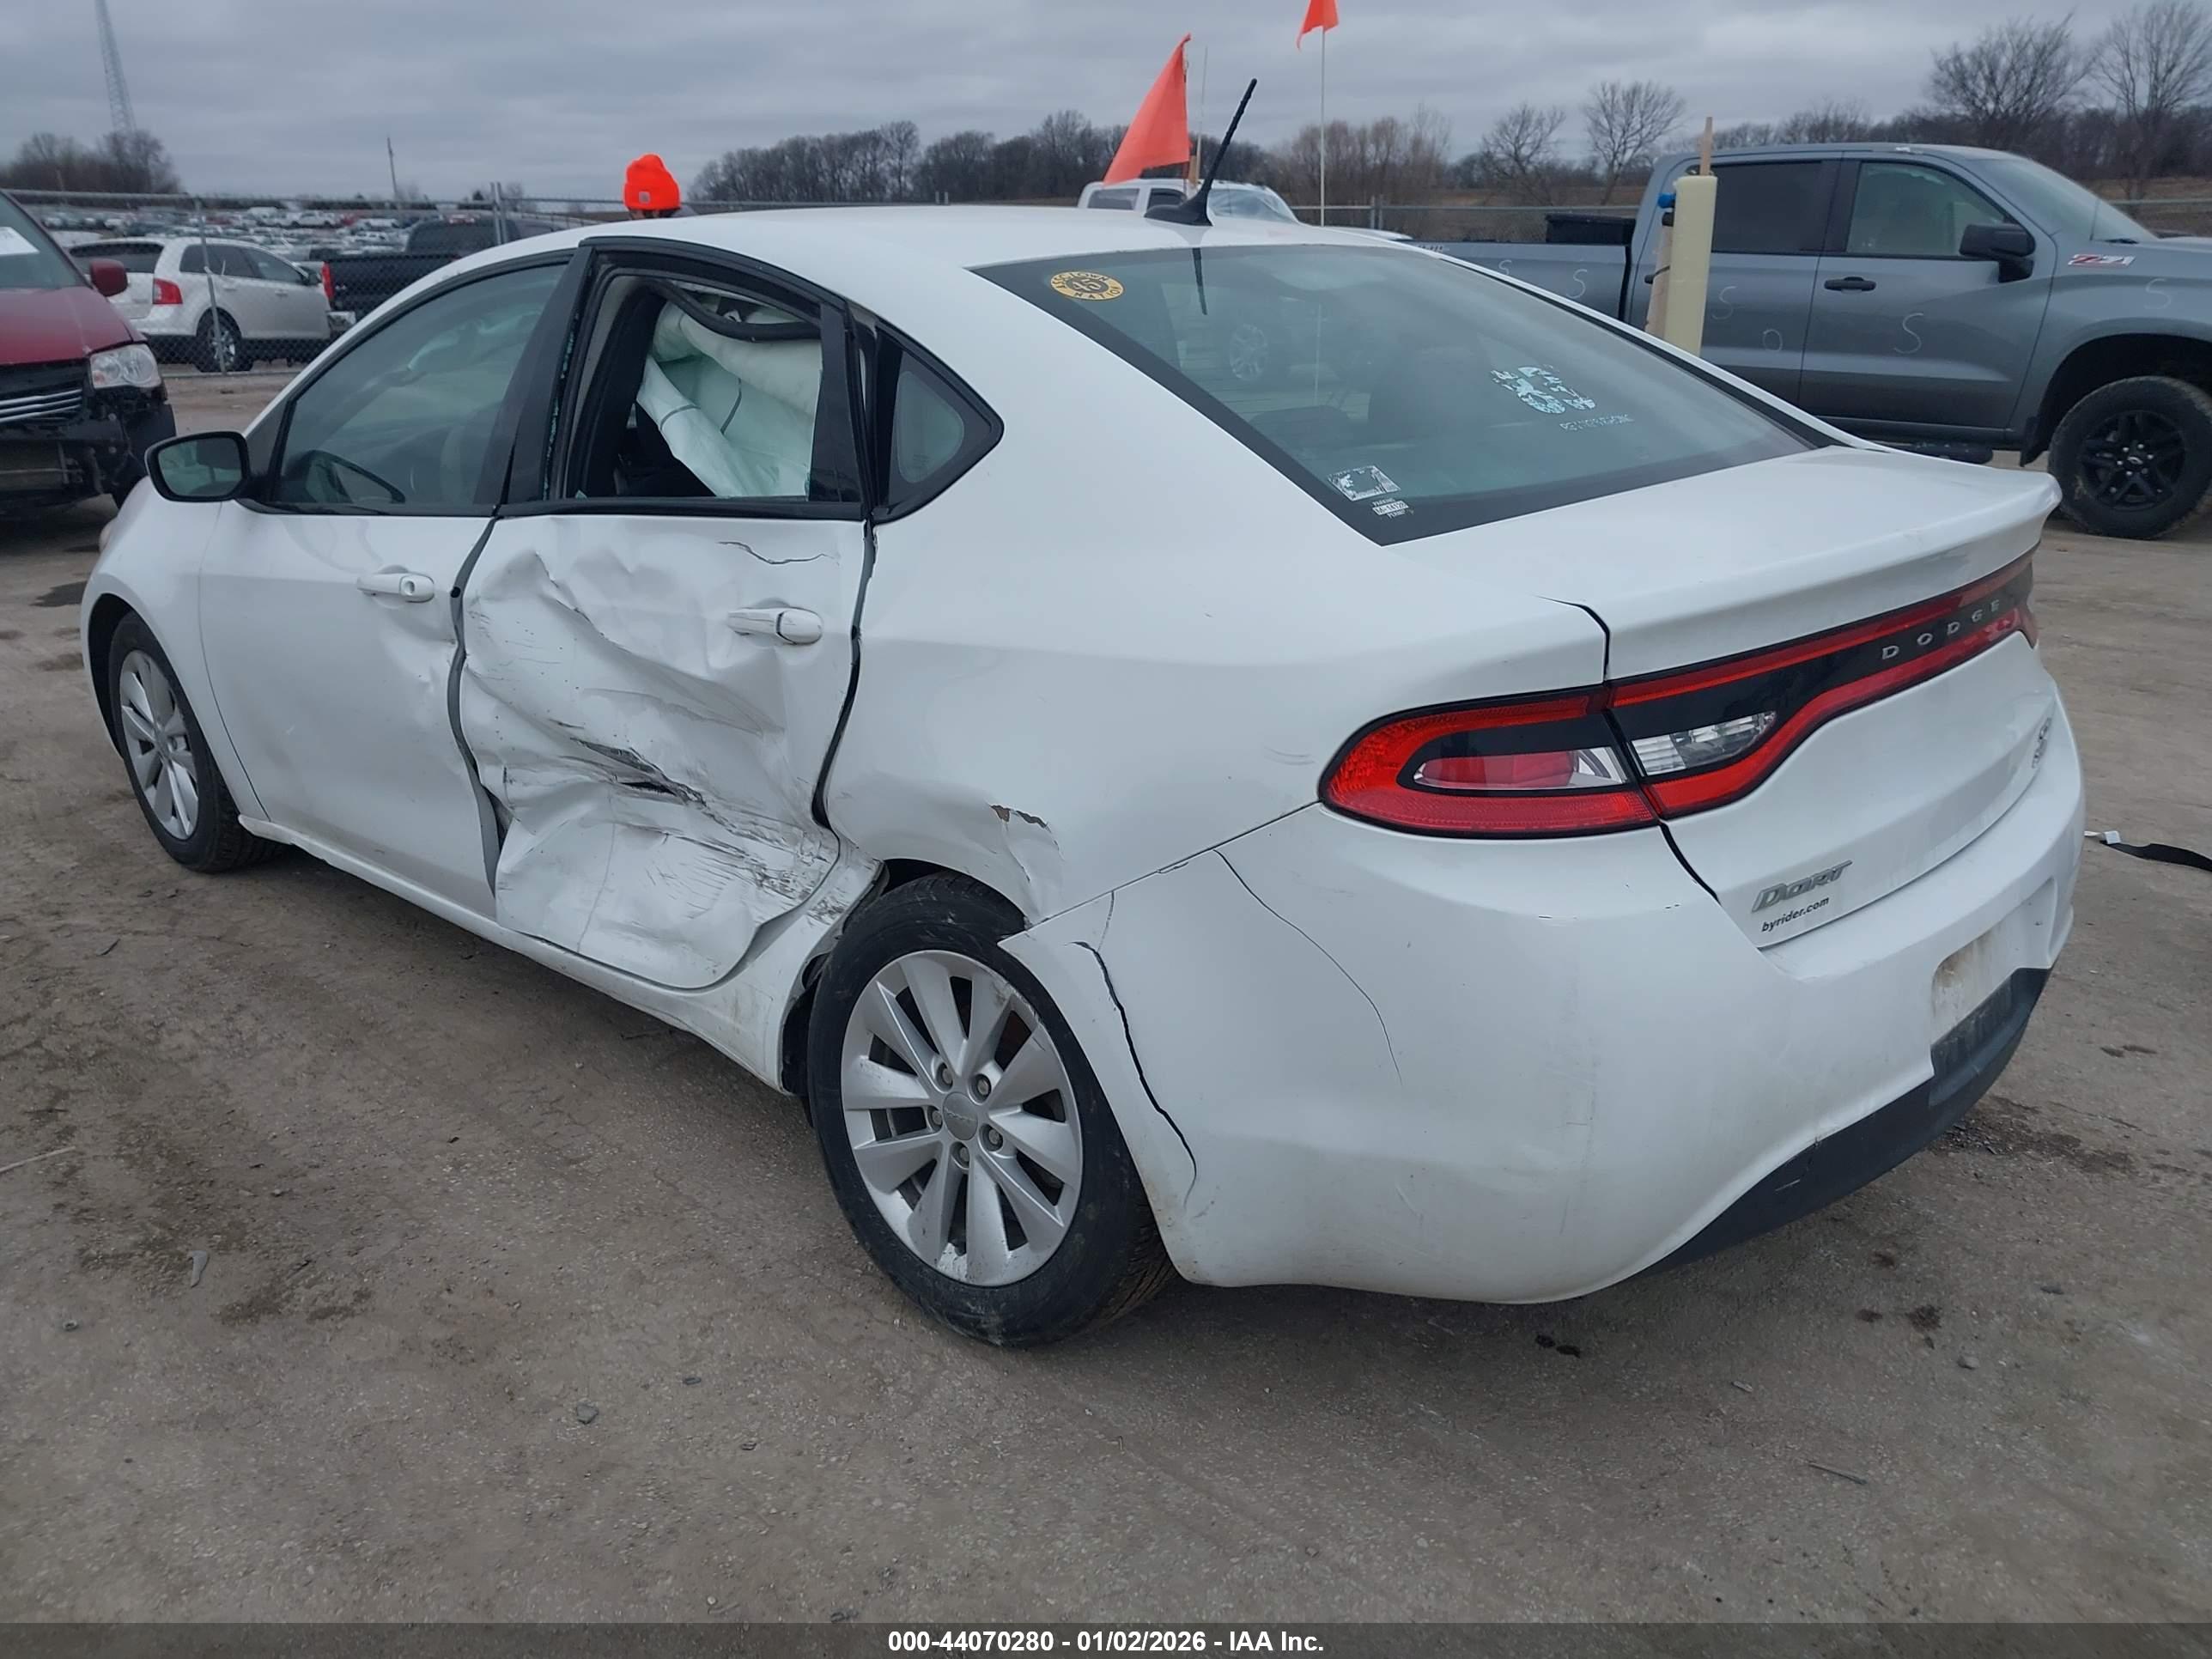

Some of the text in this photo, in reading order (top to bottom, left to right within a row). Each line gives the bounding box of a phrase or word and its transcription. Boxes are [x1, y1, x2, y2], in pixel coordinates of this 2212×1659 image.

[2068, 254, 2136, 267] Z71
[1894, 313, 1924, 354] S
[1881, 599, 2000, 660] DODGE
[1761, 897, 1830, 932] byrider.com
